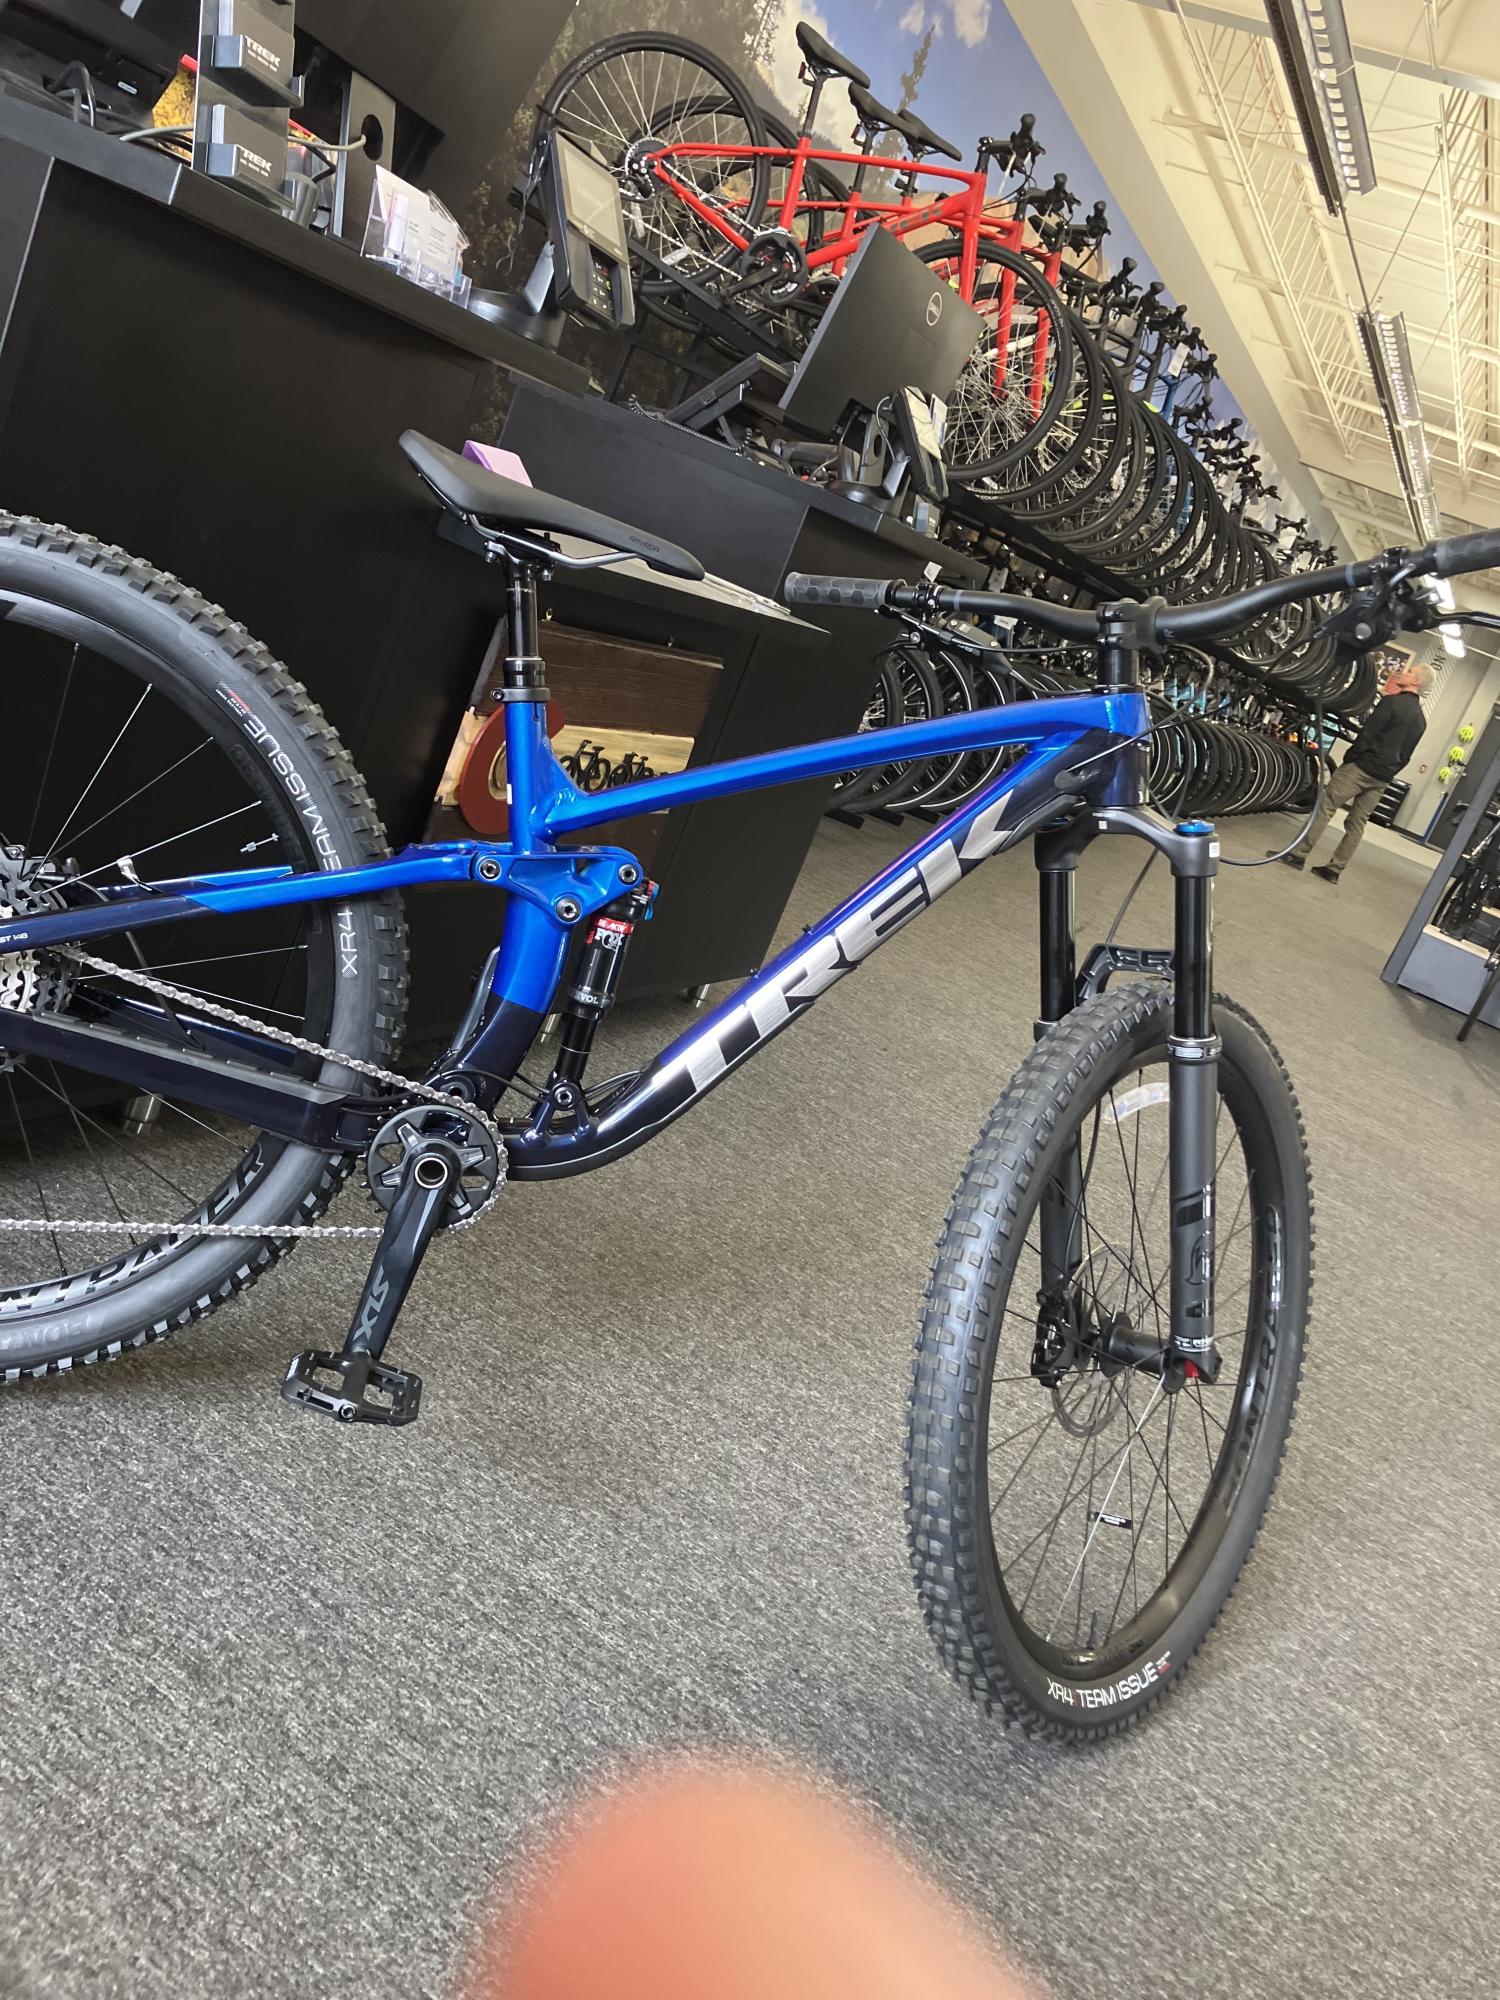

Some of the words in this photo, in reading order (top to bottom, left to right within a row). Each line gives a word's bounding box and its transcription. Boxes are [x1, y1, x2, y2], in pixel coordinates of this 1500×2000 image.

[245, 34, 281, 67] TREK
[243, 714, 311, 802] ISSUE
[302, 805, 342, 872] EAM
[337, 907, 358, 976] XR4
[594, 927, 625, 951] FOX
[604, 790, 1014, 1128] TREK
[352, 1264, 390, 1342] SLX
[1046, 1677, 1074, 1706] XR4
[1076, 1685, 1117, 1708] TEAM
[1116, 1661, 1159, 1701] ISSUE
